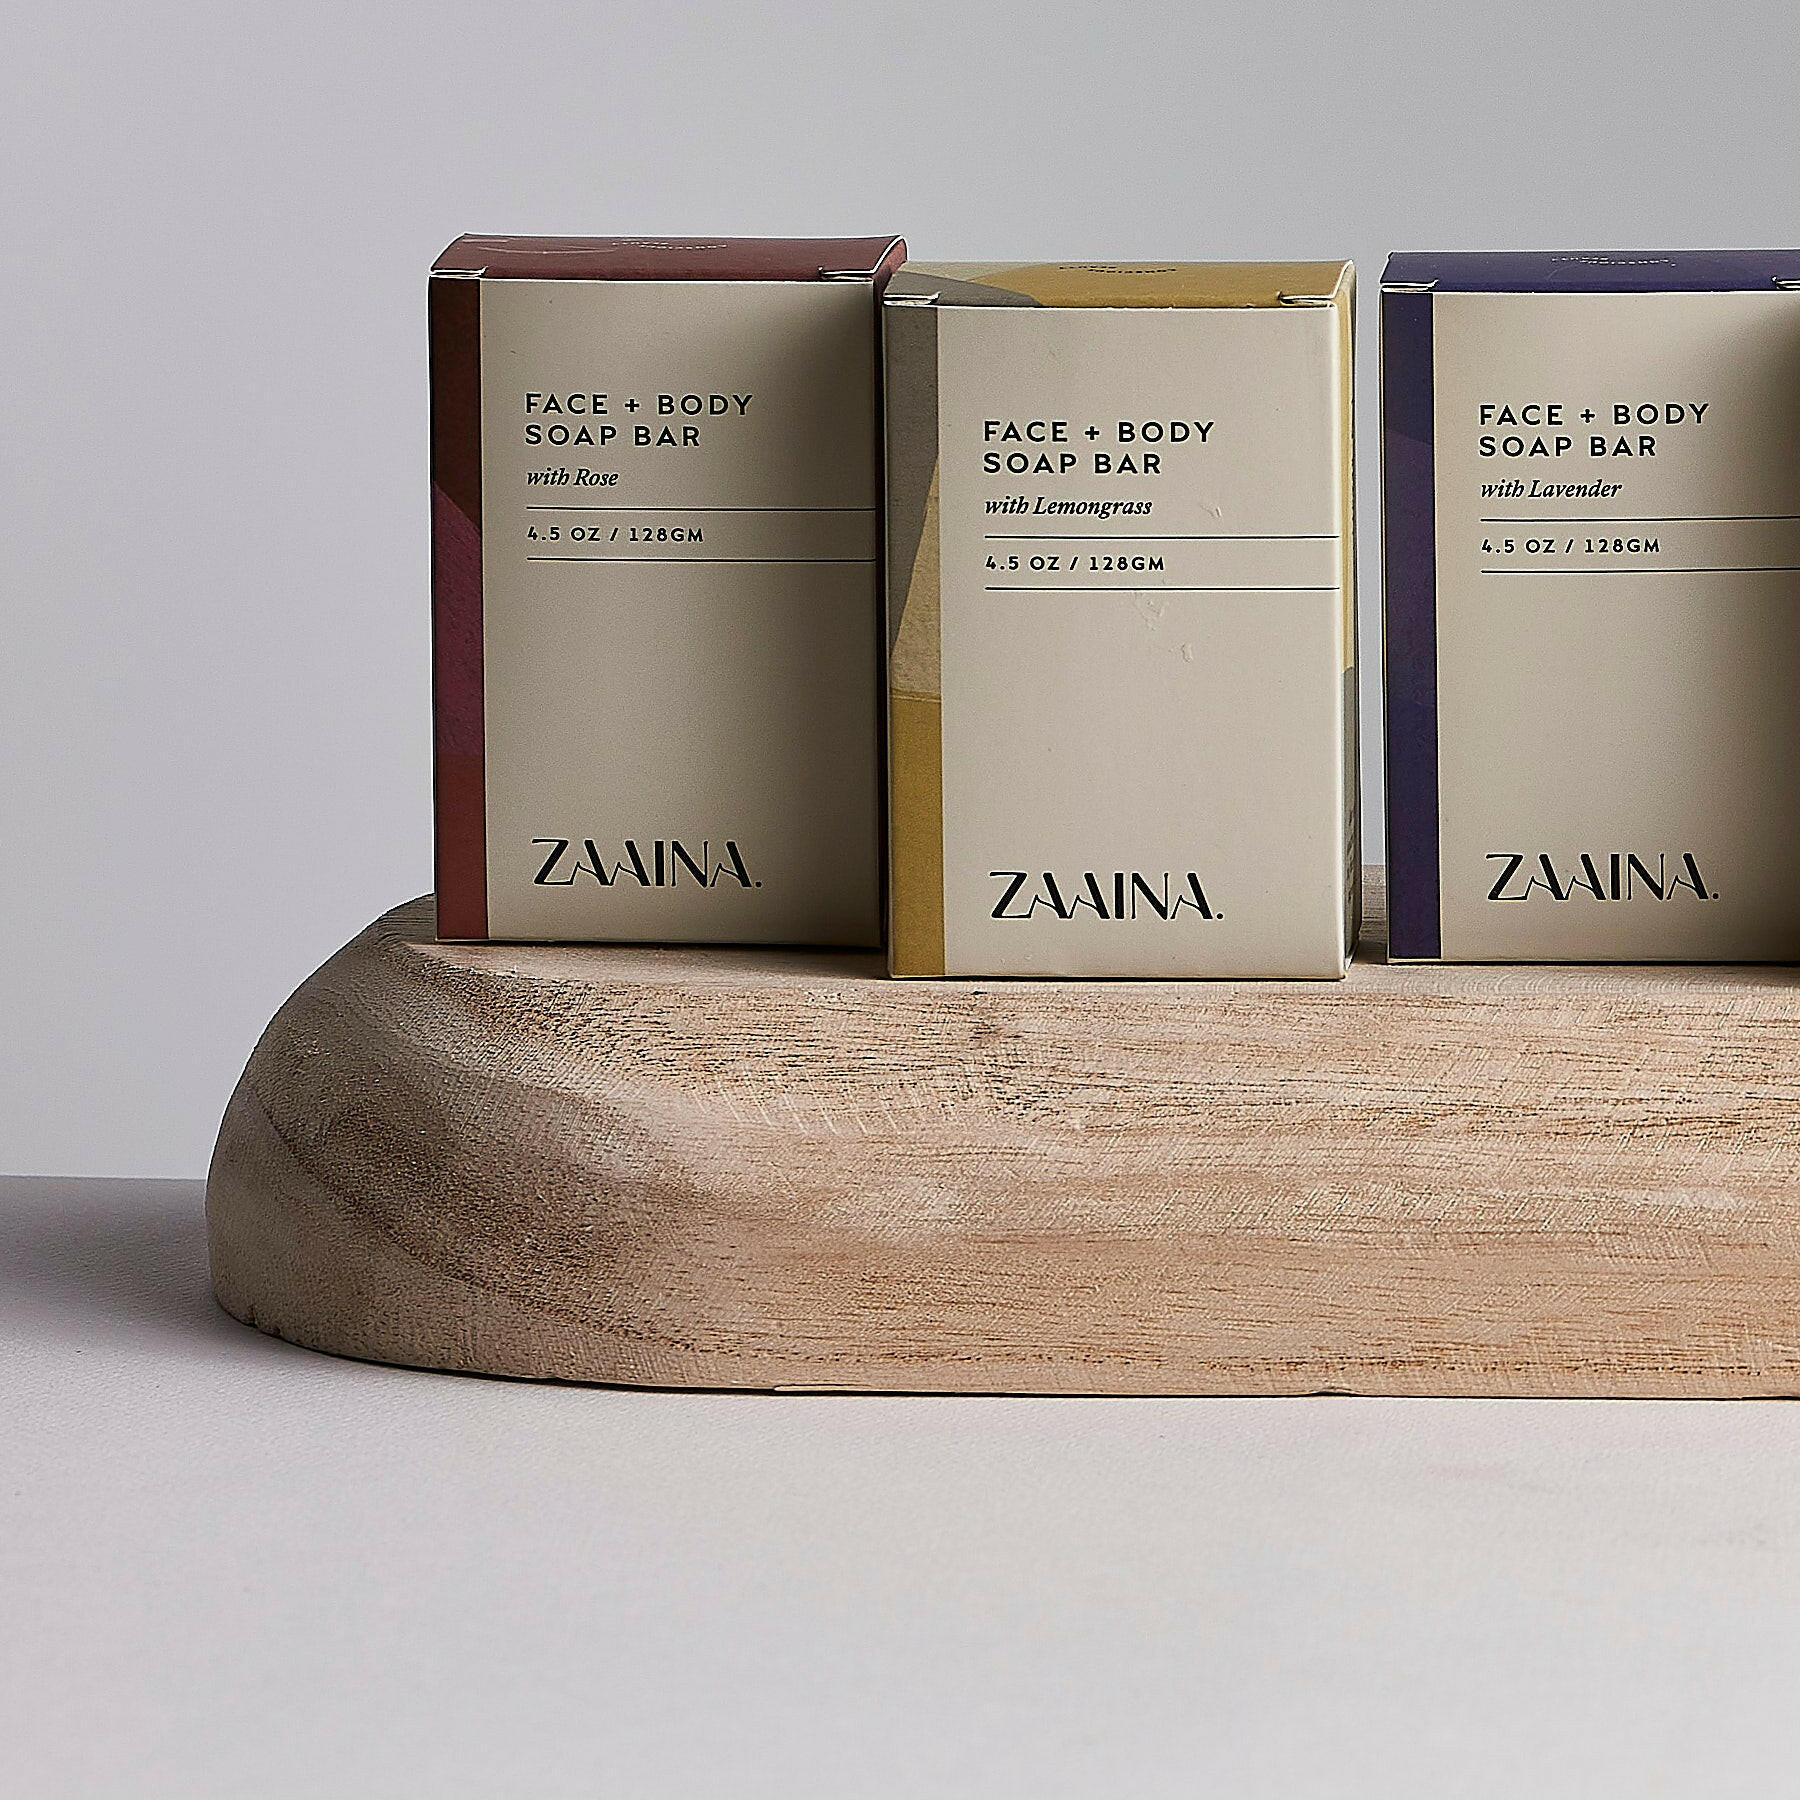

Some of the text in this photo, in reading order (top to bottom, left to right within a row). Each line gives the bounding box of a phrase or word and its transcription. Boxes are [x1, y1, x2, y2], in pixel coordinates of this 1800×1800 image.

[525, 392, 753, 416] FACE + BODY
[1479, 402, 1709, 426] FACE + BODY
[525, 424, 700, 447] SOAP BAR
[984, 420, 1215, 443] FACE + BODY
[1479, 435, 1656, 458] SOAP BAR
[983, 452, 1161, 475] SOAP BAR
[527, 466, 619, 487] with Rose
[1481, 478, 1623, 498] with Lavender
[985, 495, 1153, 520] with Lemongrass
[527, 525, 704, 543] 4.5 OZ / 128GM
[1481, 538, 1660, 554] 4.5 OZ / 128GM
[985, 555, 1164, 571] 4.5 OZ / 128GM
